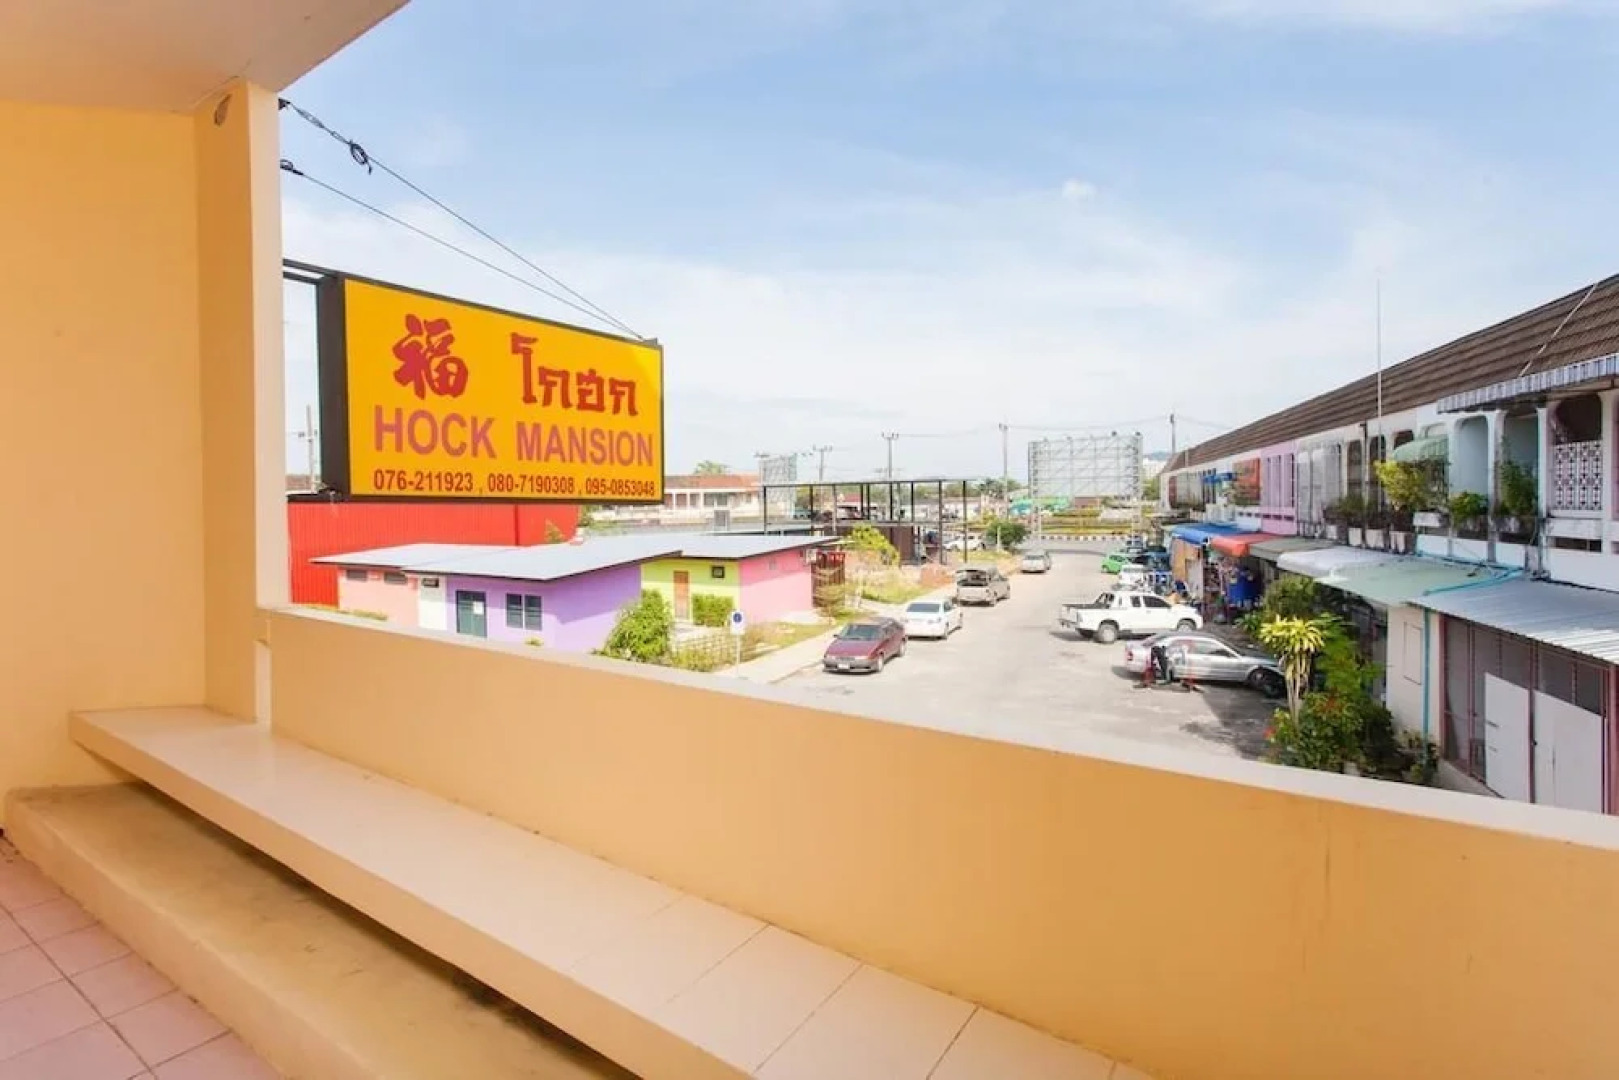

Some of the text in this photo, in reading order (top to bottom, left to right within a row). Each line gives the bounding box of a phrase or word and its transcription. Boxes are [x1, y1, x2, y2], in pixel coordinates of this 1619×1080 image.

[392, 313, 469, 400] 福
[373, 404, 654, 466] HOCK MANSION
[373, 469, 473, 492] 076-211923
[488, 473, 575, 494] 080-7190308
